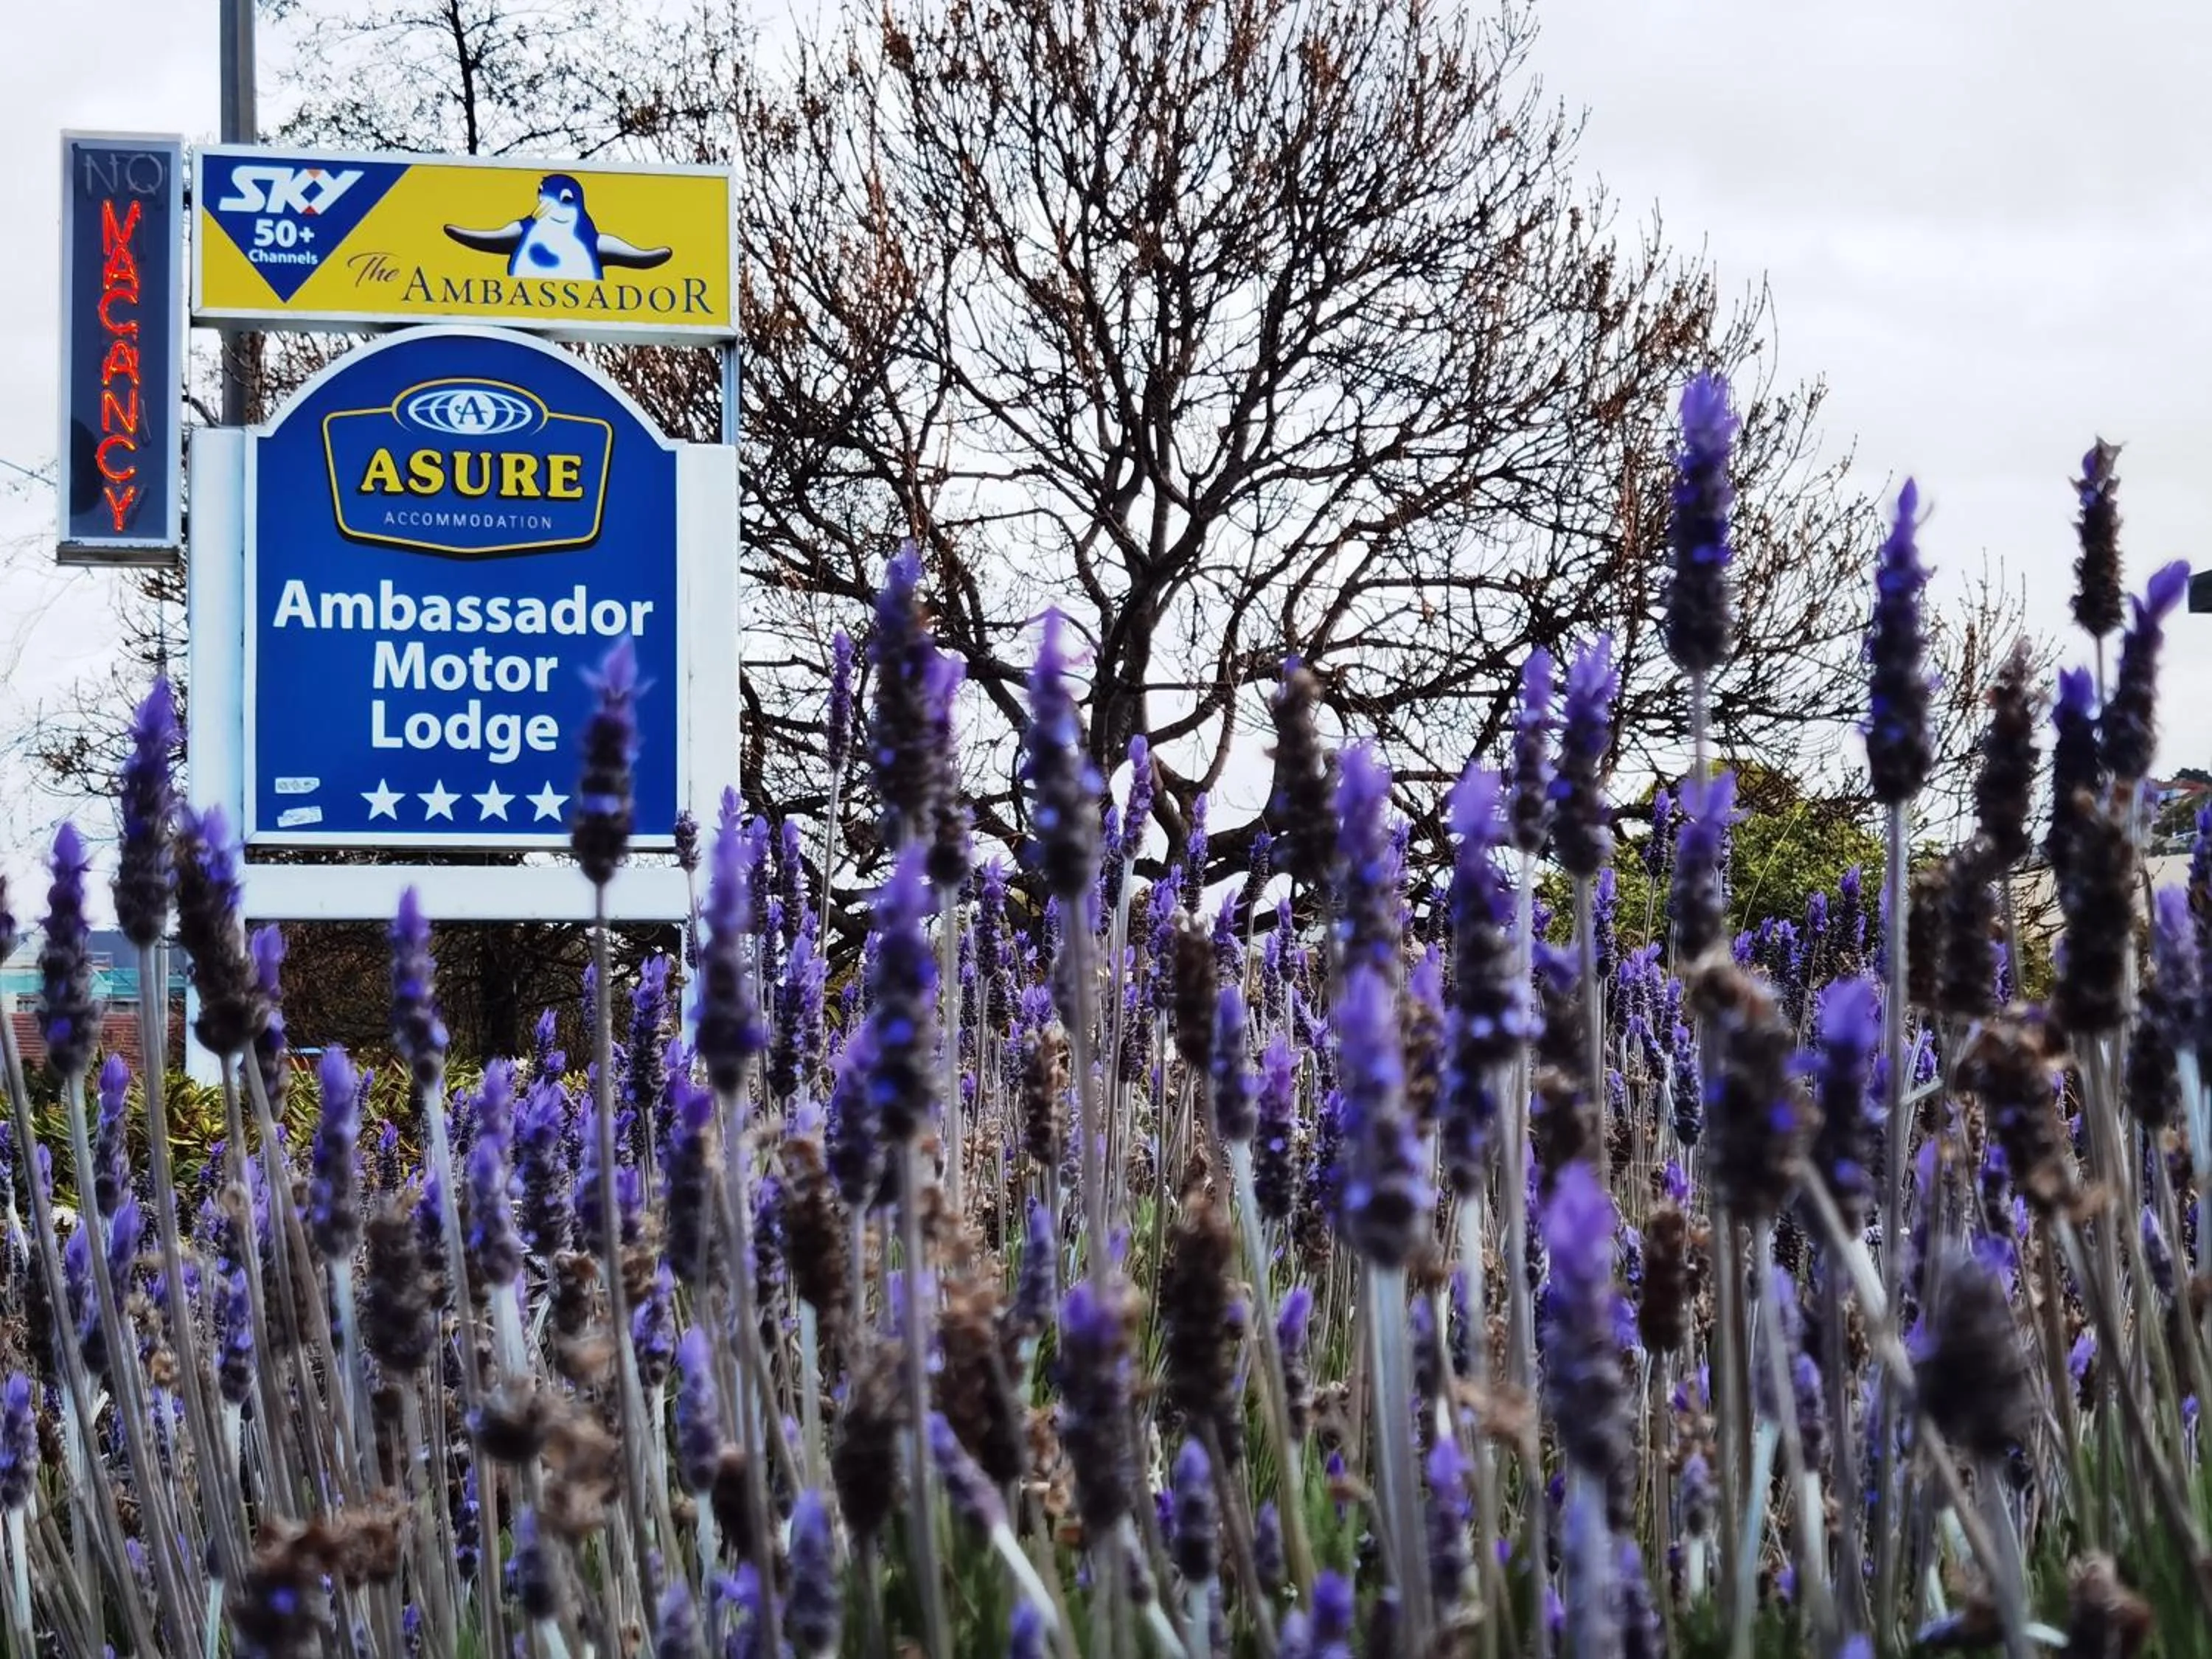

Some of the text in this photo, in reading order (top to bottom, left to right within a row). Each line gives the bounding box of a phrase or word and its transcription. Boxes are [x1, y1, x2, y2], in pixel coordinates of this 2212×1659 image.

[219, 166, 364, 215] SKY
[248, 249, 318, 265] Channels
[254, 219, 315, 247] 50+
[347, 251, 714, 315] The AMBASSADOR
[96, 199, 141, 532] VACANCY
[360, 448, 584, 499] ASURE
[383, 512, 553, 529] ACCOMMODATION
[273, 580, 653, 636] Ambassador
[373, 641, 557, 692] Motor
[372, 699, 558, 764] Lodge
